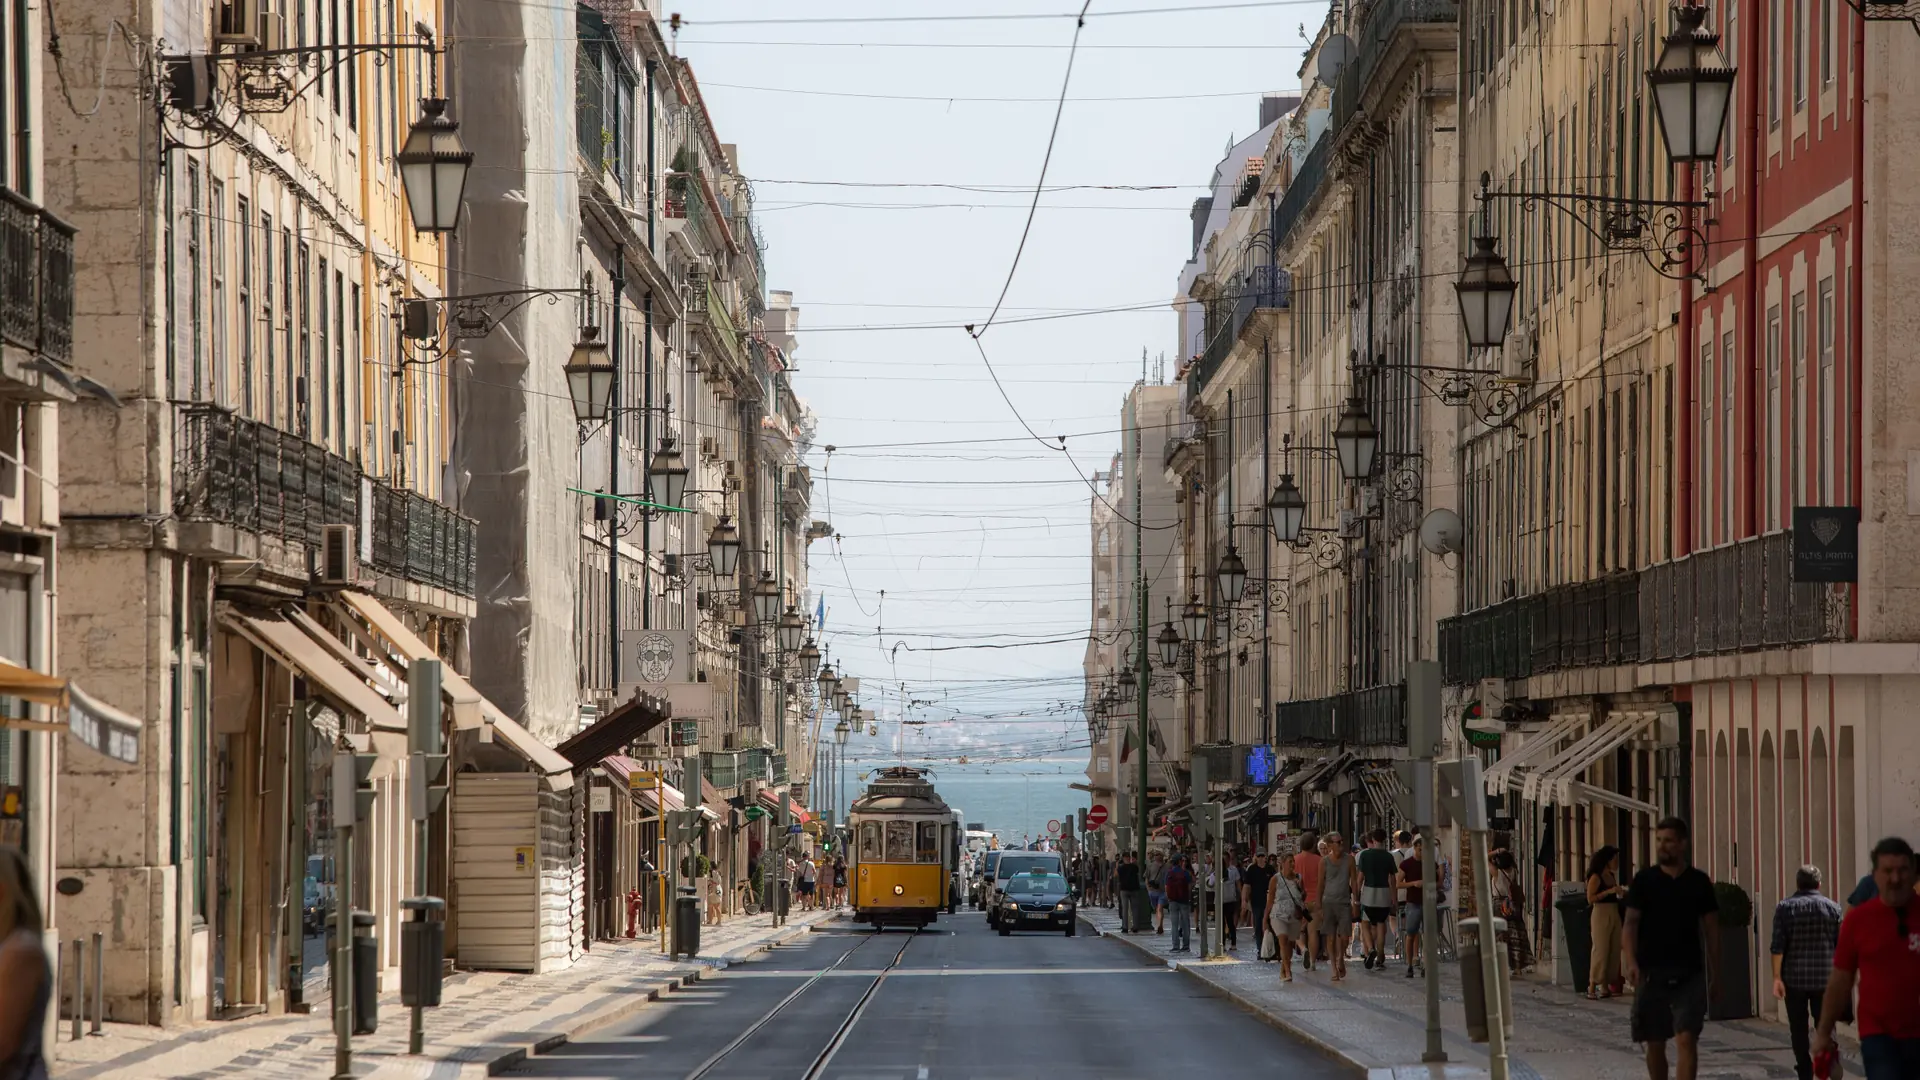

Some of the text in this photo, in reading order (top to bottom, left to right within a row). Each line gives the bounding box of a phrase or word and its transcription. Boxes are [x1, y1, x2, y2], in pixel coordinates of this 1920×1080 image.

[1799, 551, 1854, 560] ALTIS PRATA
[1473, 732, 1500, 742] JOGOS
